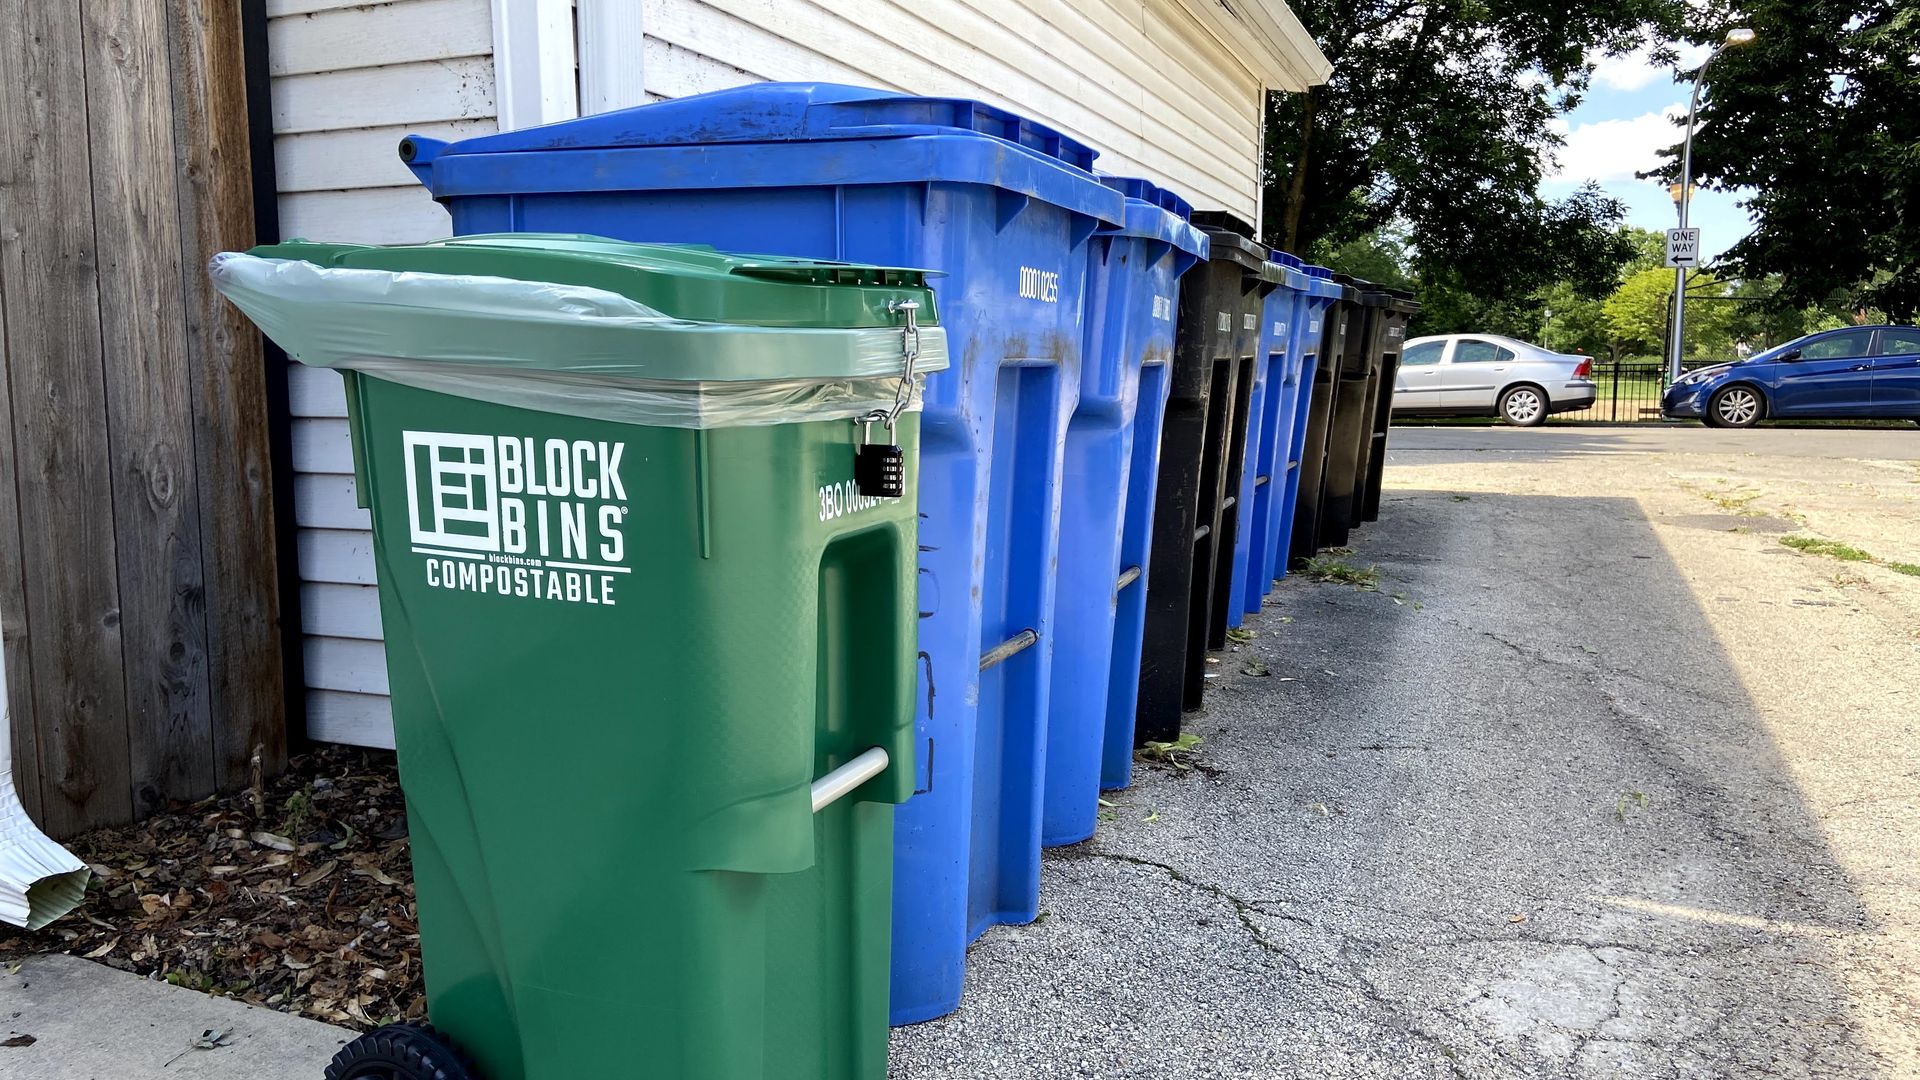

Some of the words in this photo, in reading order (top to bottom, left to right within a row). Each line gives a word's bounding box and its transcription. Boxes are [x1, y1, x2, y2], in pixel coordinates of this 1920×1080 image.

[1672, 231, 1695, 241] ONE
[1672, 243, 1694, 252] WAY
[1019, 265, 1059, 304] 000010255
[497, 435, 628, 501] BLOCK
[488, 553, 542, 567] blockbins.com
[426, 558, 616, 606] COMPOSTABLE
